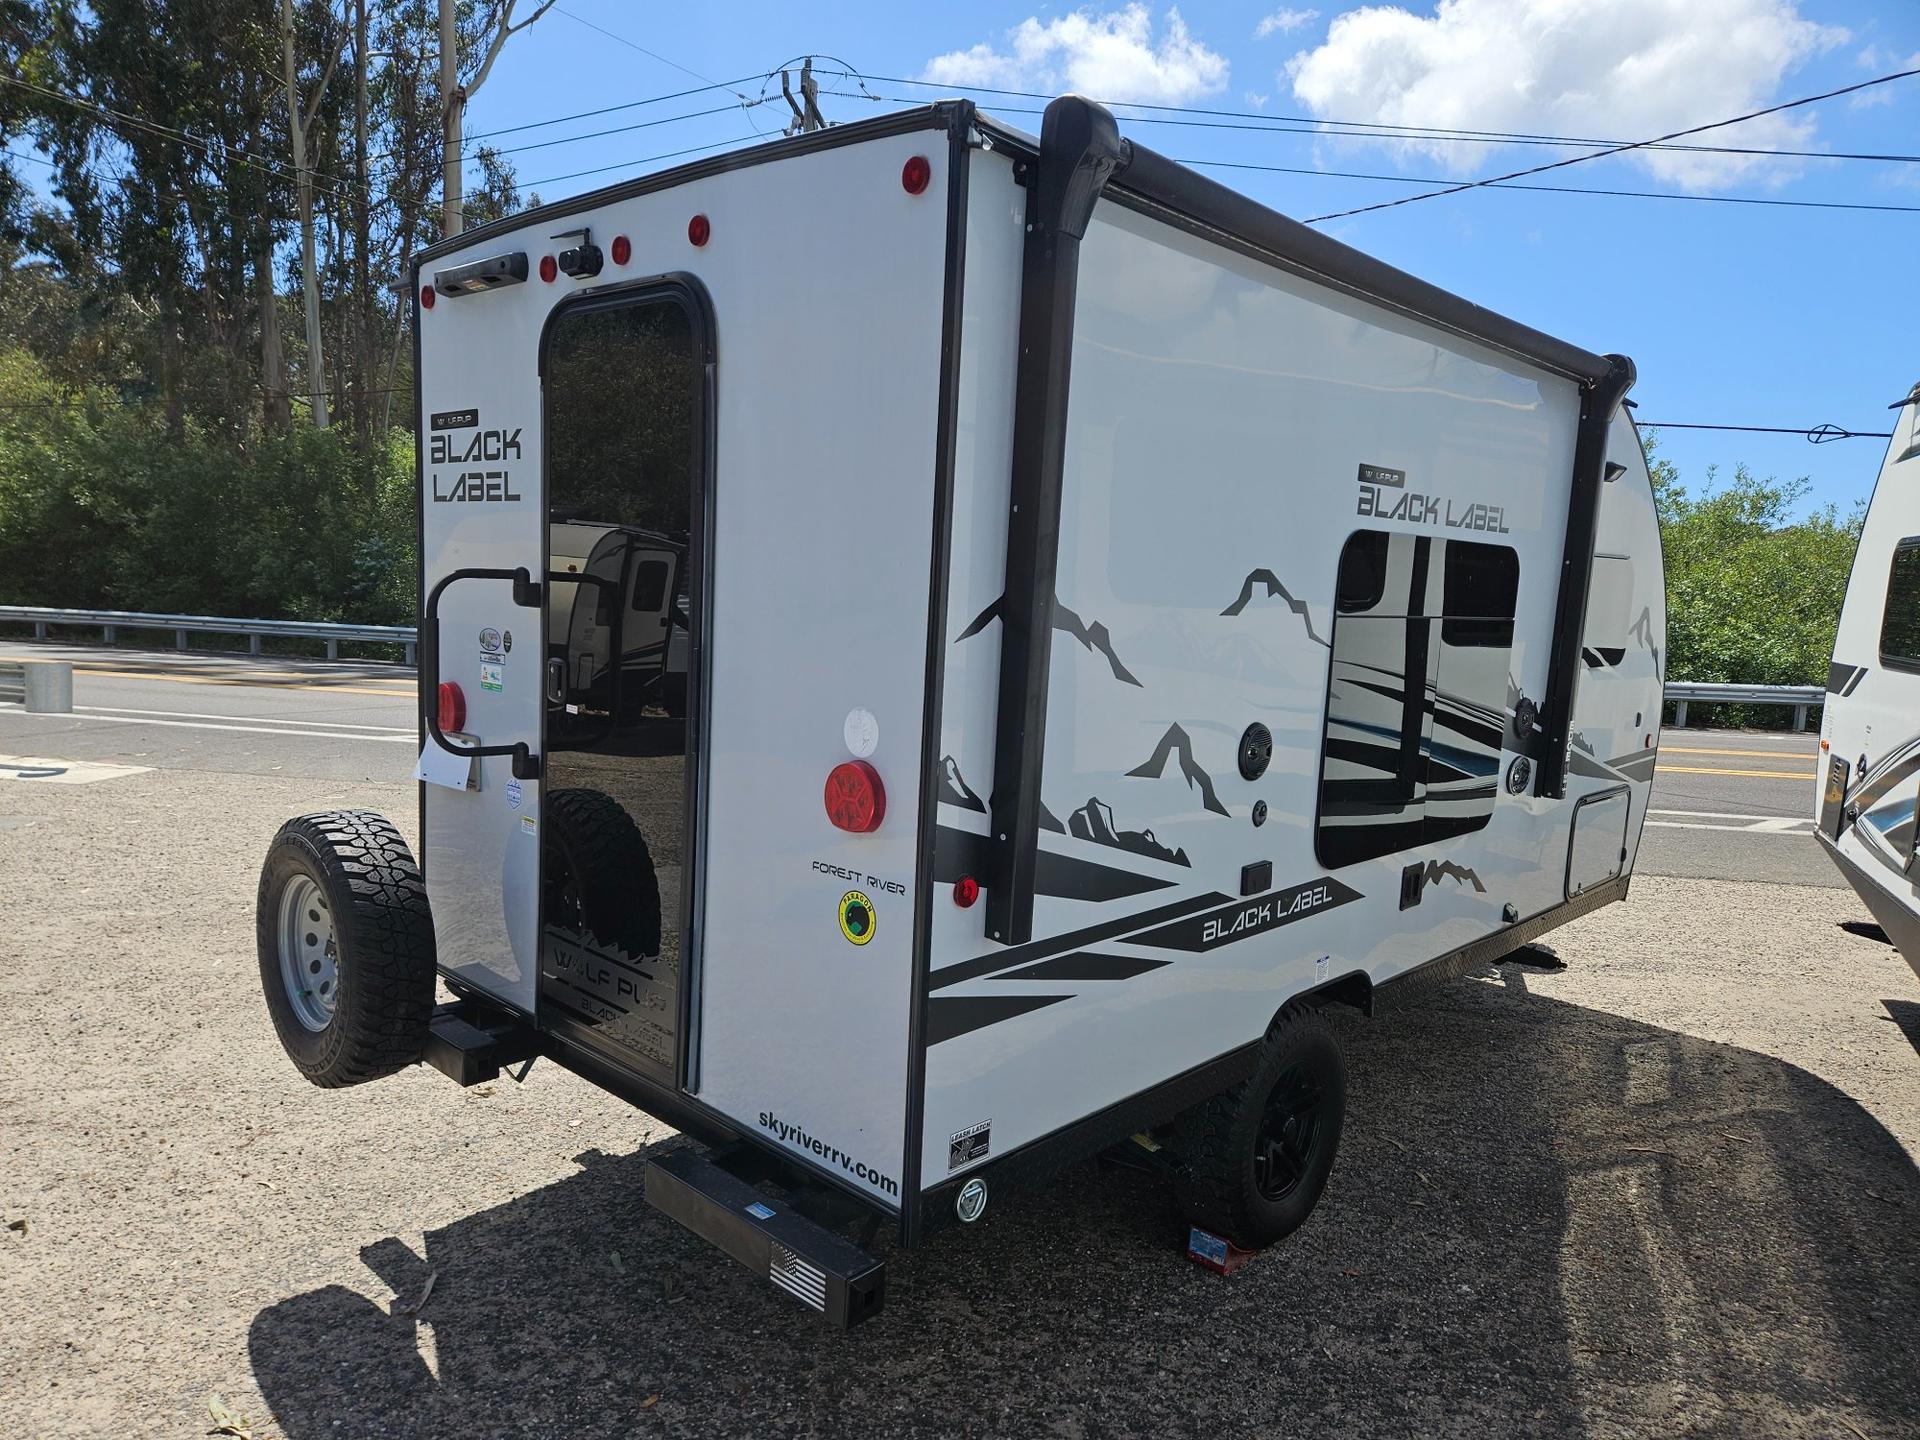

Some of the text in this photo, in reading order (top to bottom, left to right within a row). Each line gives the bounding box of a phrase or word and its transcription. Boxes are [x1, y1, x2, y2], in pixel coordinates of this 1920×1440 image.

[431, 428, 522, 464] BLACK
[433, 471, 521, 502] LABEL
[1357, 485, 1509, 534] BLACK LABEL
[812, 861, 906, 896] FOREST RIVER
[843, 893, 873, 913] PARAGON
[1202, 885, 1333, 942] BLACK LABEL
[972, 1121, 991, 1134] LATCH
[759, 1111, 899, 1197] skyriverrv.com
